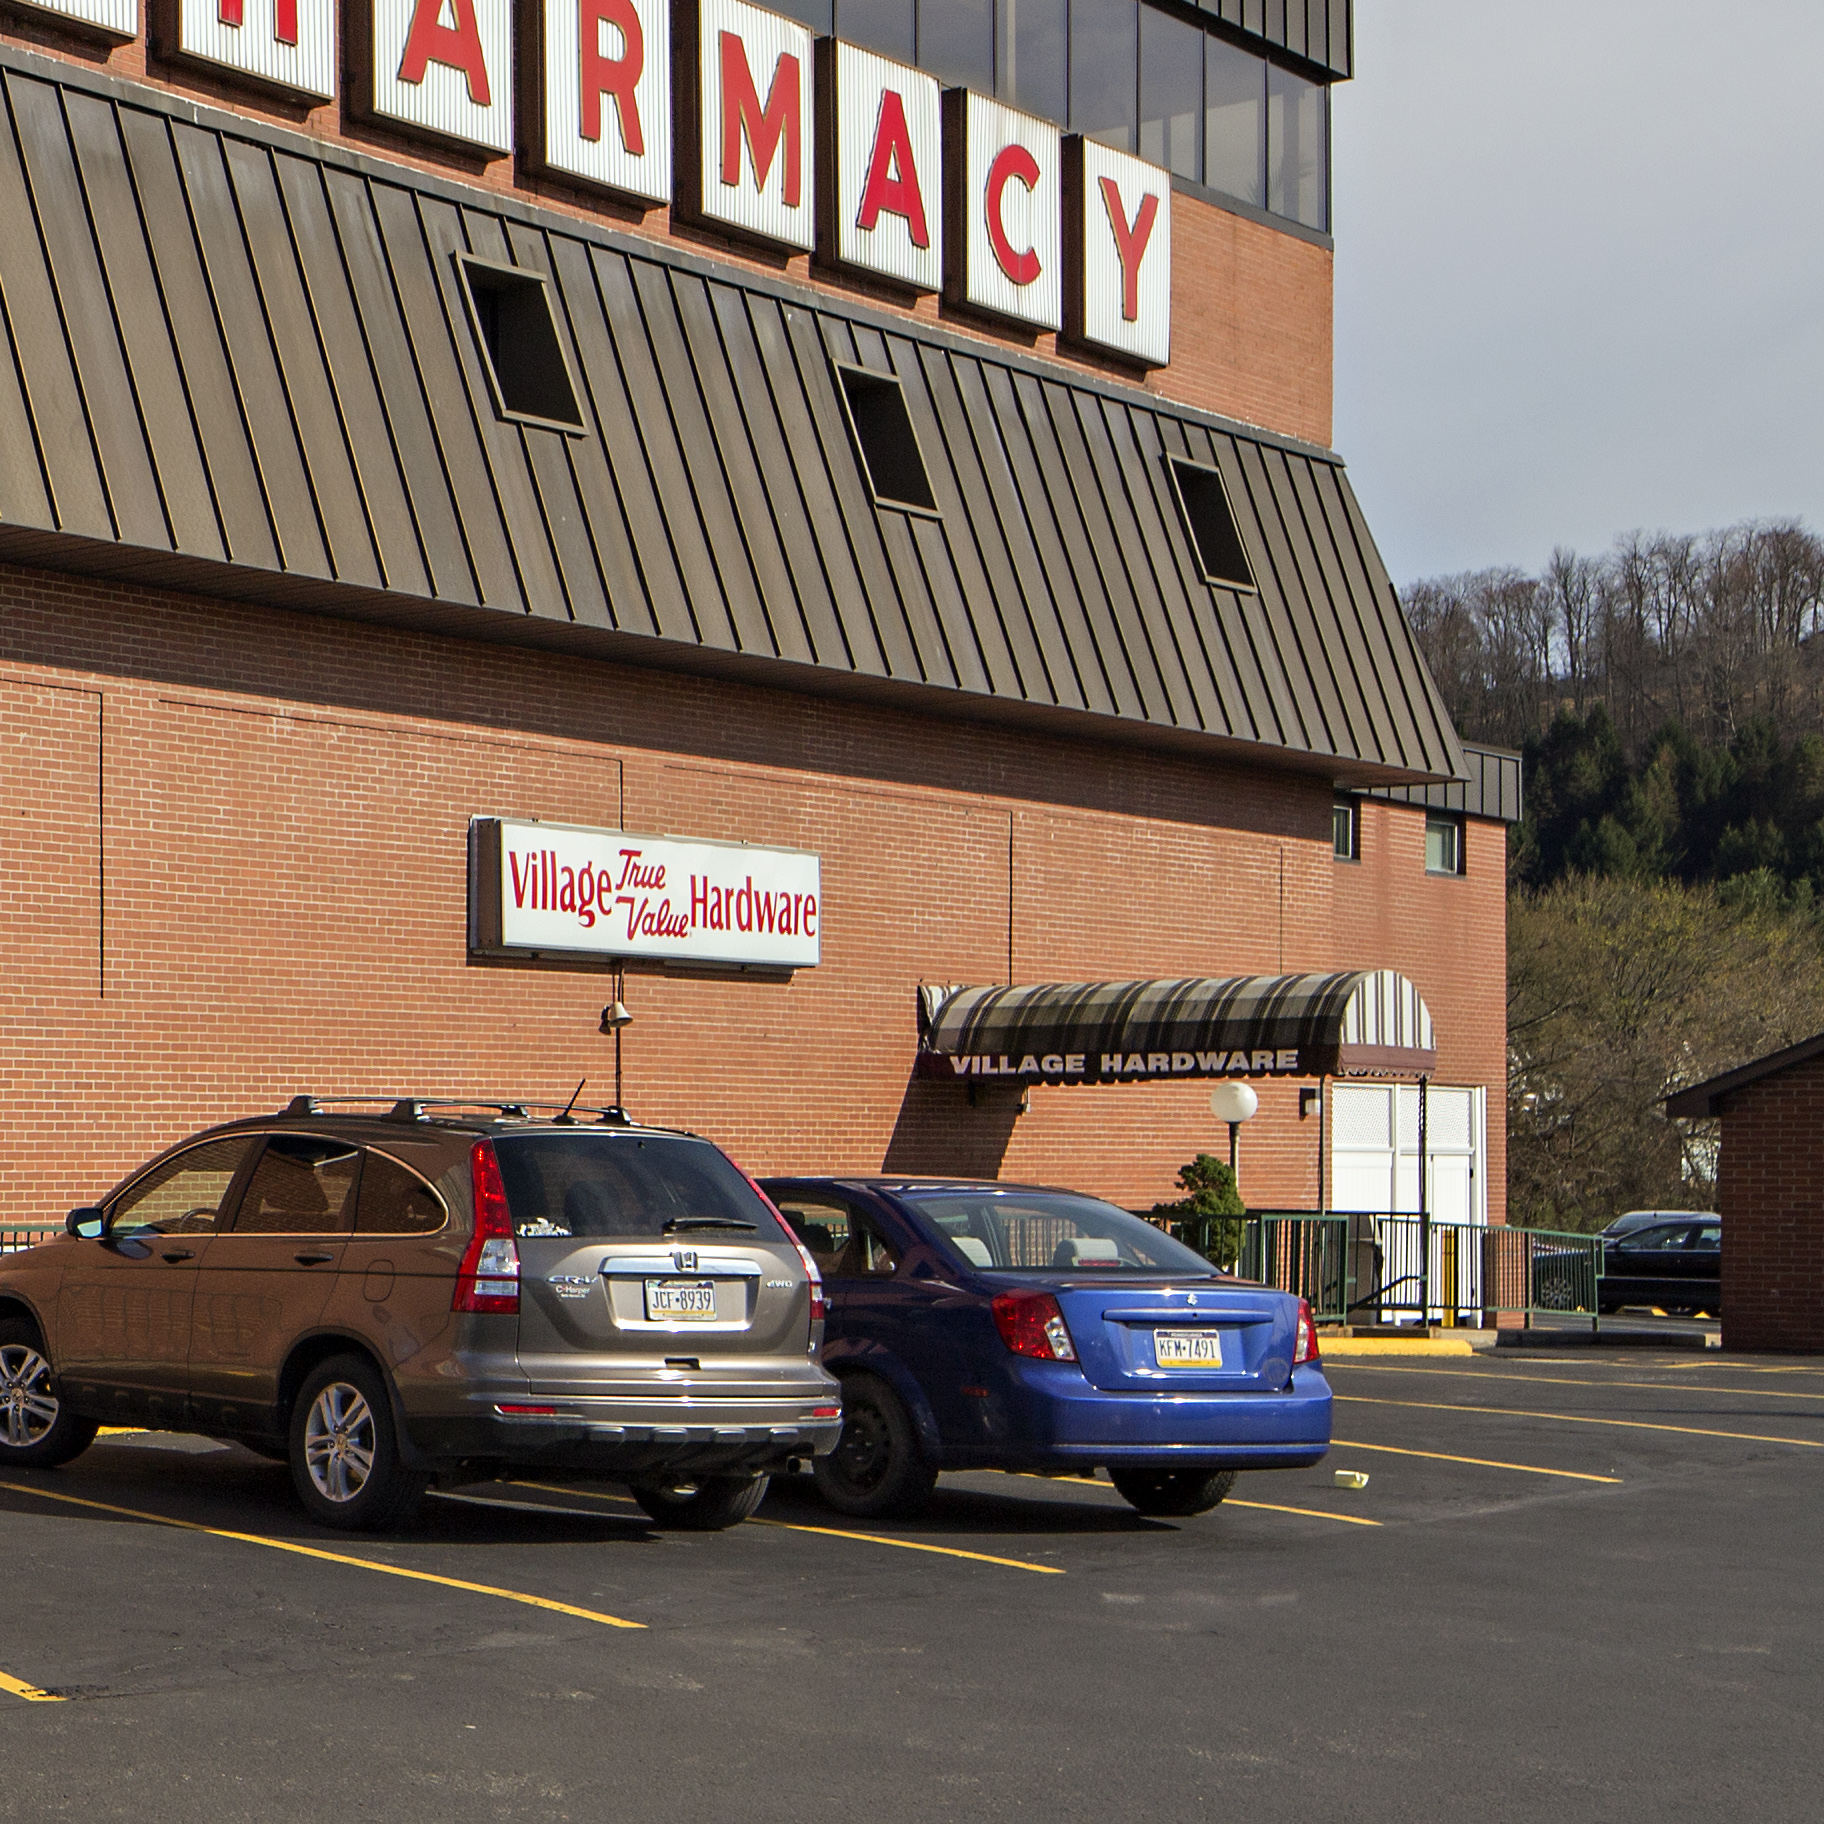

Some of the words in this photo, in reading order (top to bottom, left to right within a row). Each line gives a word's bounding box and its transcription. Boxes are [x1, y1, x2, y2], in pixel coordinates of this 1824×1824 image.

[509, 850, 612, 927] Village
[616, 850, 666, 890] True
[615, 896, 689, 941] Value
[691, 875, 816, 937] Hardware
[950, 1053, 1084, 1076] VILLAGE
[1101, 1049, 1299, 1074] HARDWARE
